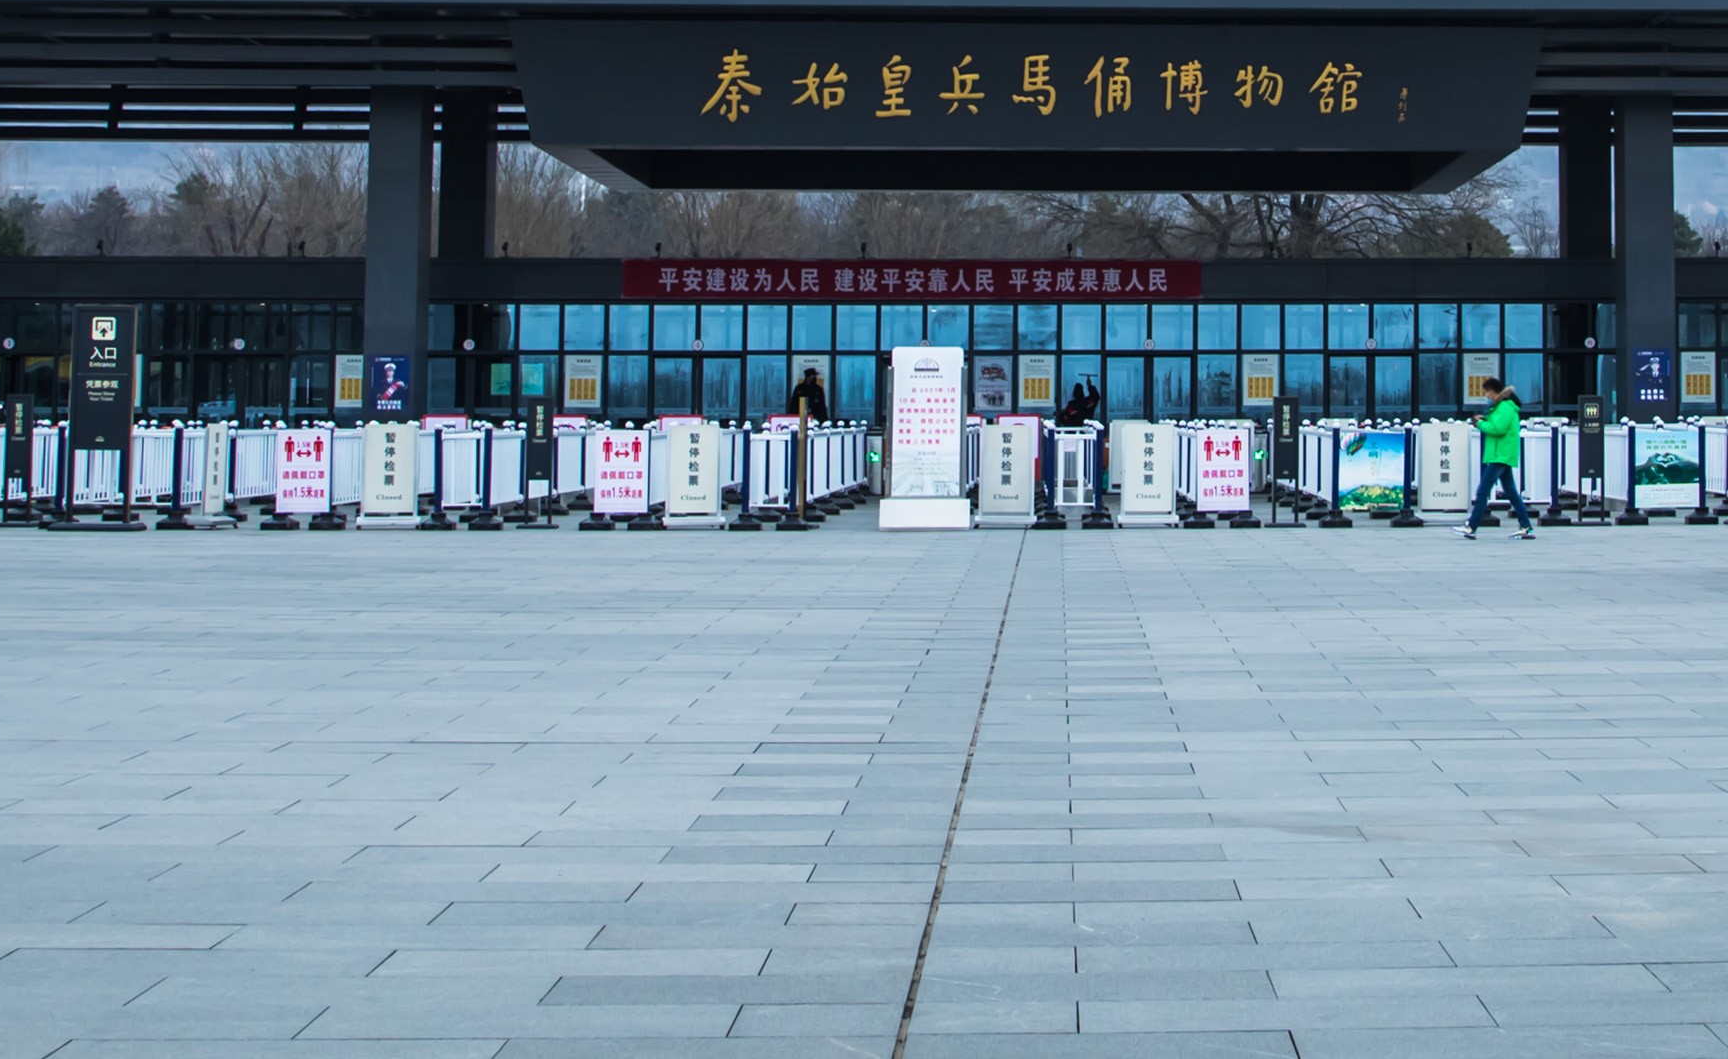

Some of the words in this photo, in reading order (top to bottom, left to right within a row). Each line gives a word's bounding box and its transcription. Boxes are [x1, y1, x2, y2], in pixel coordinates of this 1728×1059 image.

[659, 267, 821, 293] 平安建设为人民
[834, 267, 995, 293] 建设平安靠人民
[1008, 267, 1168, 293] 平安成果惠人民
[90, 346, 117, 359] 入口
[384, 432, 396, 486] 暂停检票
[688, 433, 700, 486] 暂停检票
[1001, 433, 1012, 486] 暂停检票
[1143, 433, 1154, 485] 暂停检票
[1440, 431, 1450, 483] 暂停检票
